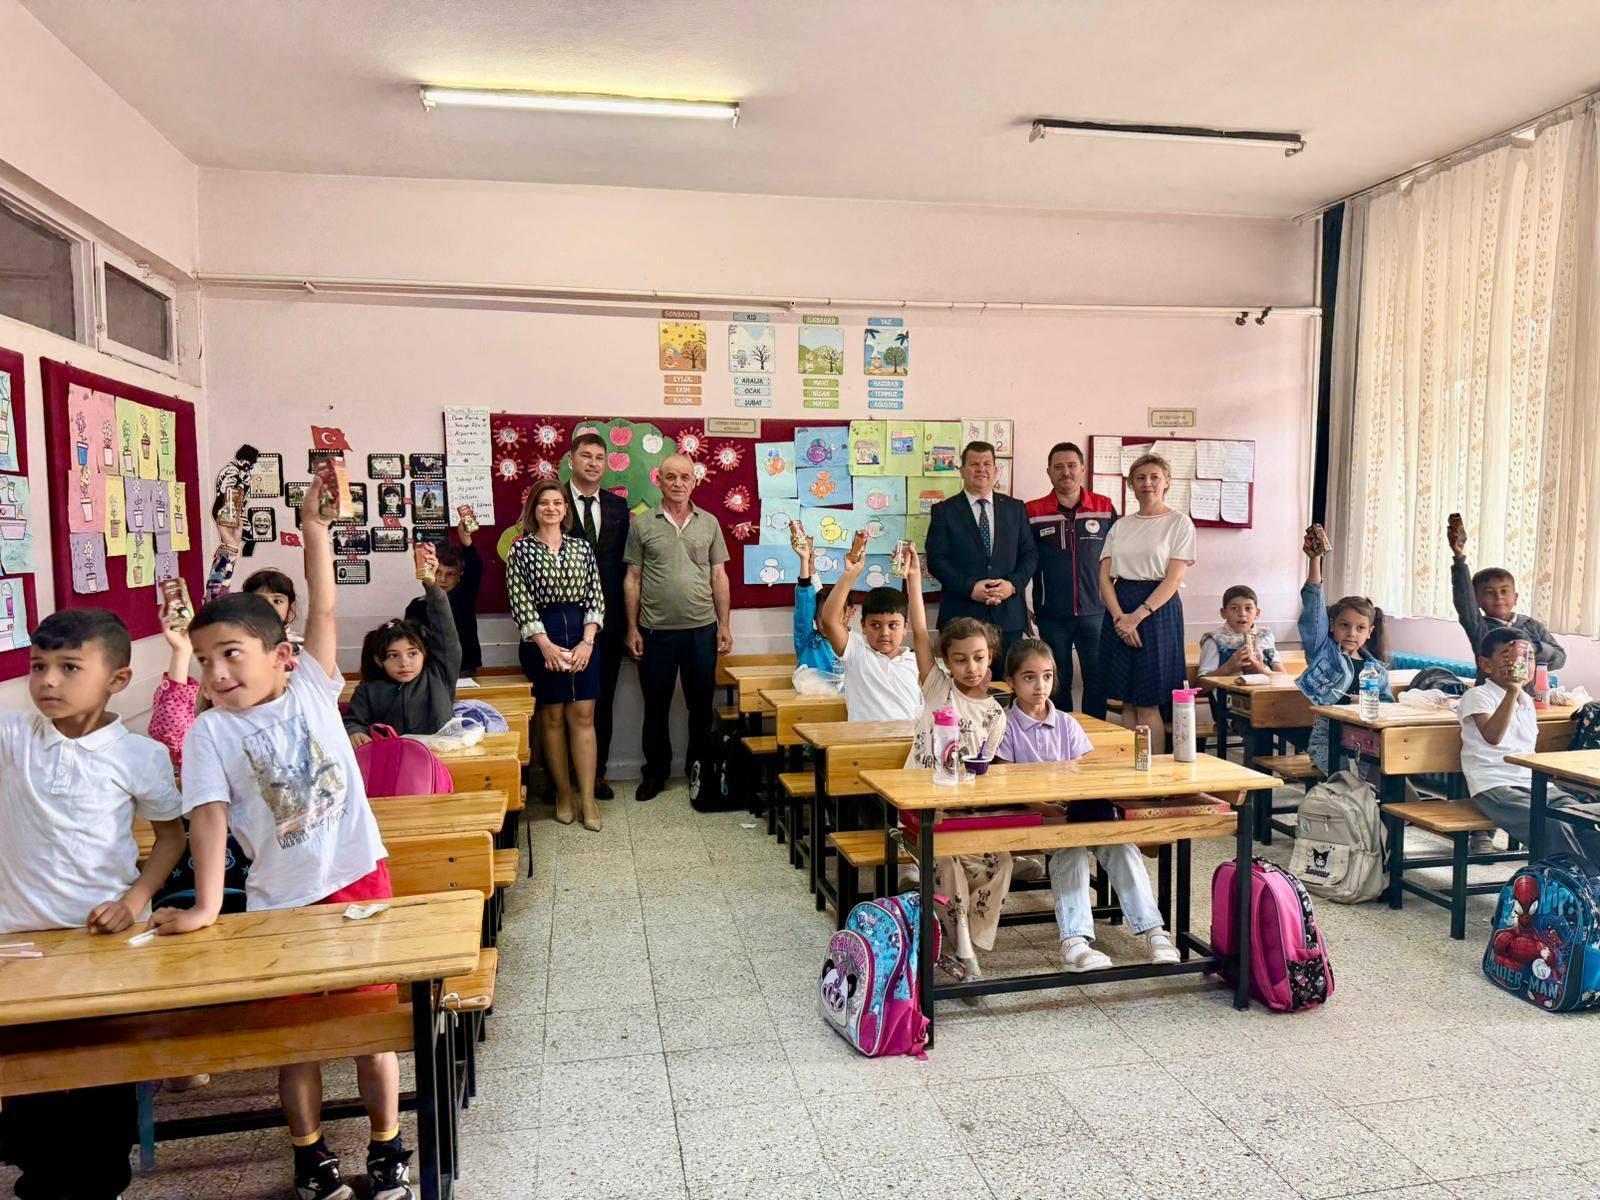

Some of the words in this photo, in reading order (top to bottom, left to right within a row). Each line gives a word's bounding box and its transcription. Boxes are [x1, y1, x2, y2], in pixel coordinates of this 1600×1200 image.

[744, 387, 761, 395] OCAK
[995, 440, 1003, 452] 2
[993, 480, 1001, 490] 4
[1484, 959, 1559, 999] SPIDER-MAN
